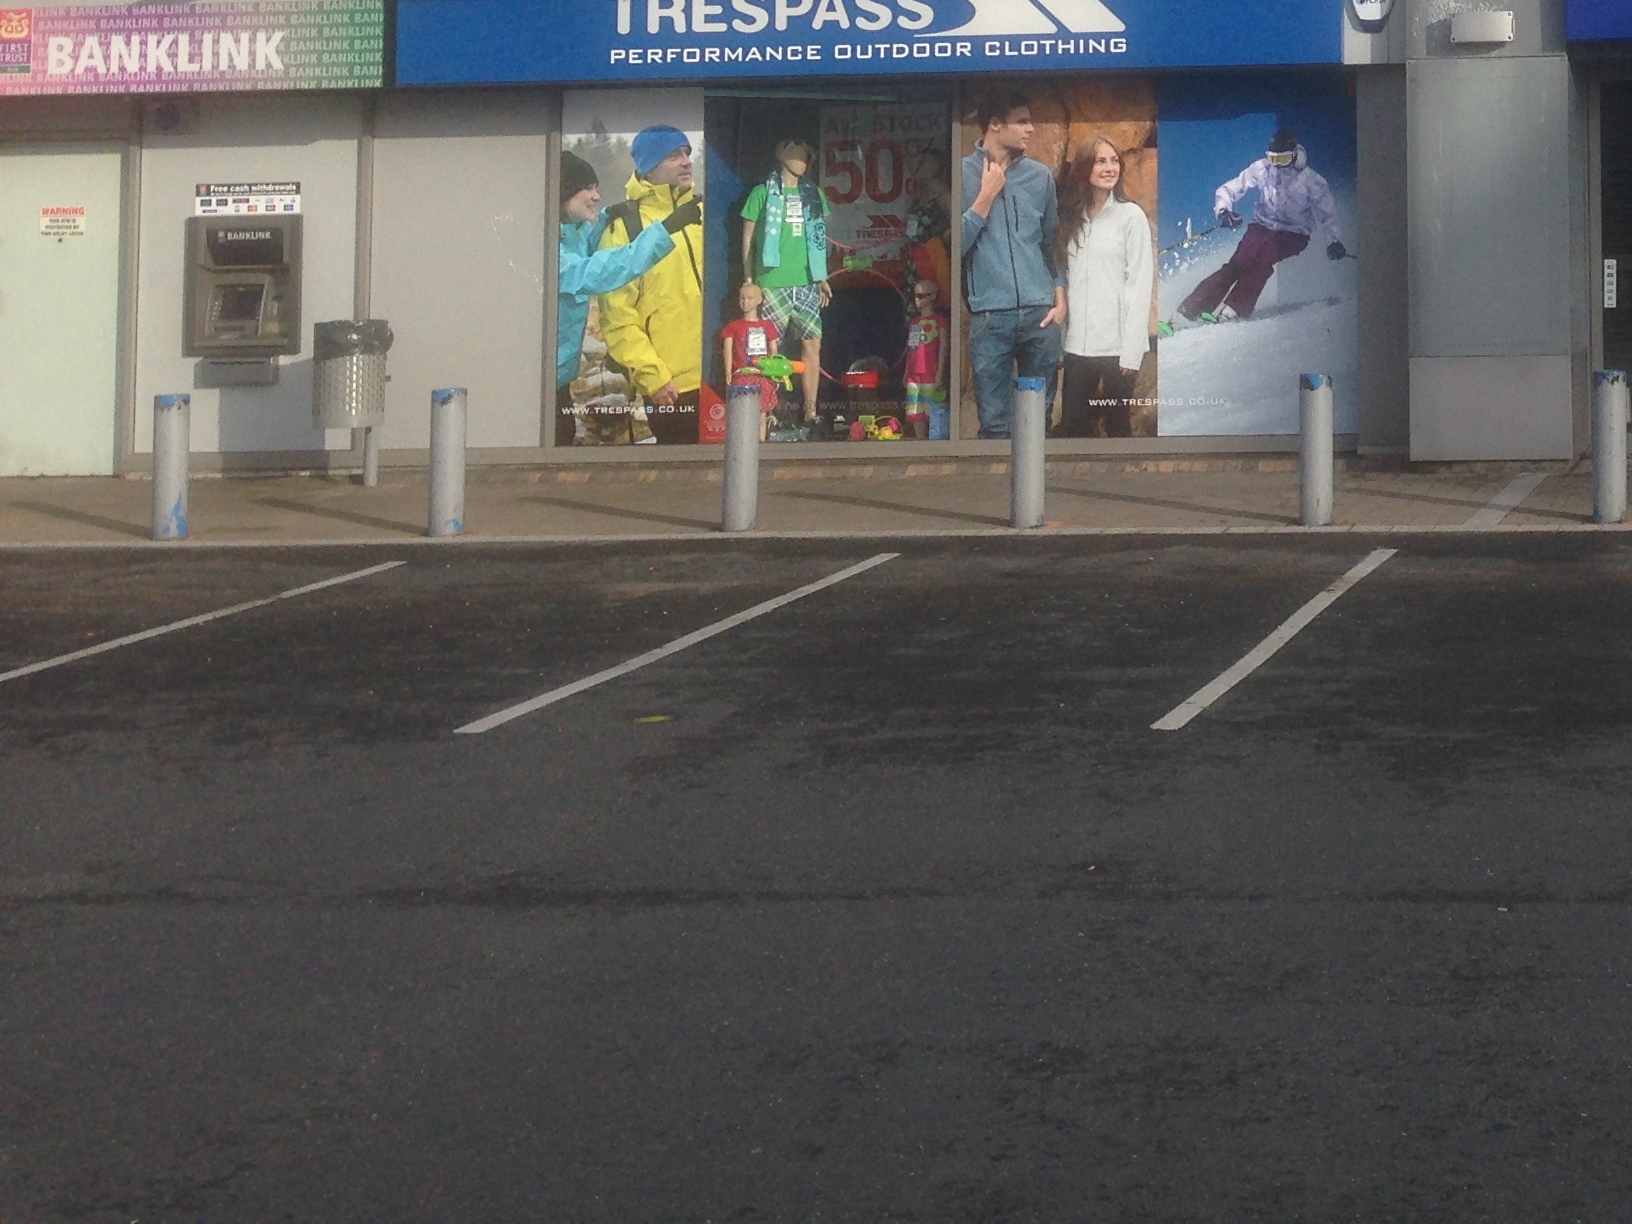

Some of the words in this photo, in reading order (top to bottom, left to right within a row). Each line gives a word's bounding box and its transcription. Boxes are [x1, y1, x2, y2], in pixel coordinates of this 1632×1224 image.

[323, 0, 383, 10] BANKLINK
[38, 19, 96, 29] BANKLINK
[100, 18, 159, 28] BANKLINK
[163, 16, 222, 27] BANKLINK
[227, 15, 286, 26] BANKLINK
[290, 14, 350, 25] BANKLINK
[322, 27, 383, 37] BANKLINK
[290, 40, 349, 51] BANKLINK
[610, 43, 823, 65] PERFORMANCE
[834, 41, 973, 60] OUTDOOR
[984, 37, 1128, 56] CLOTHING
[48, 31, 285, 76] BANKLINK
[322, 52, 383, 63] BANKLINK
[290, 66, 350, 77] BANKLINK
[230, 184, 249, 192] cash
[42, 206, 84, 215] WARNING
[227, 230, 272, 240] BANKLINK
